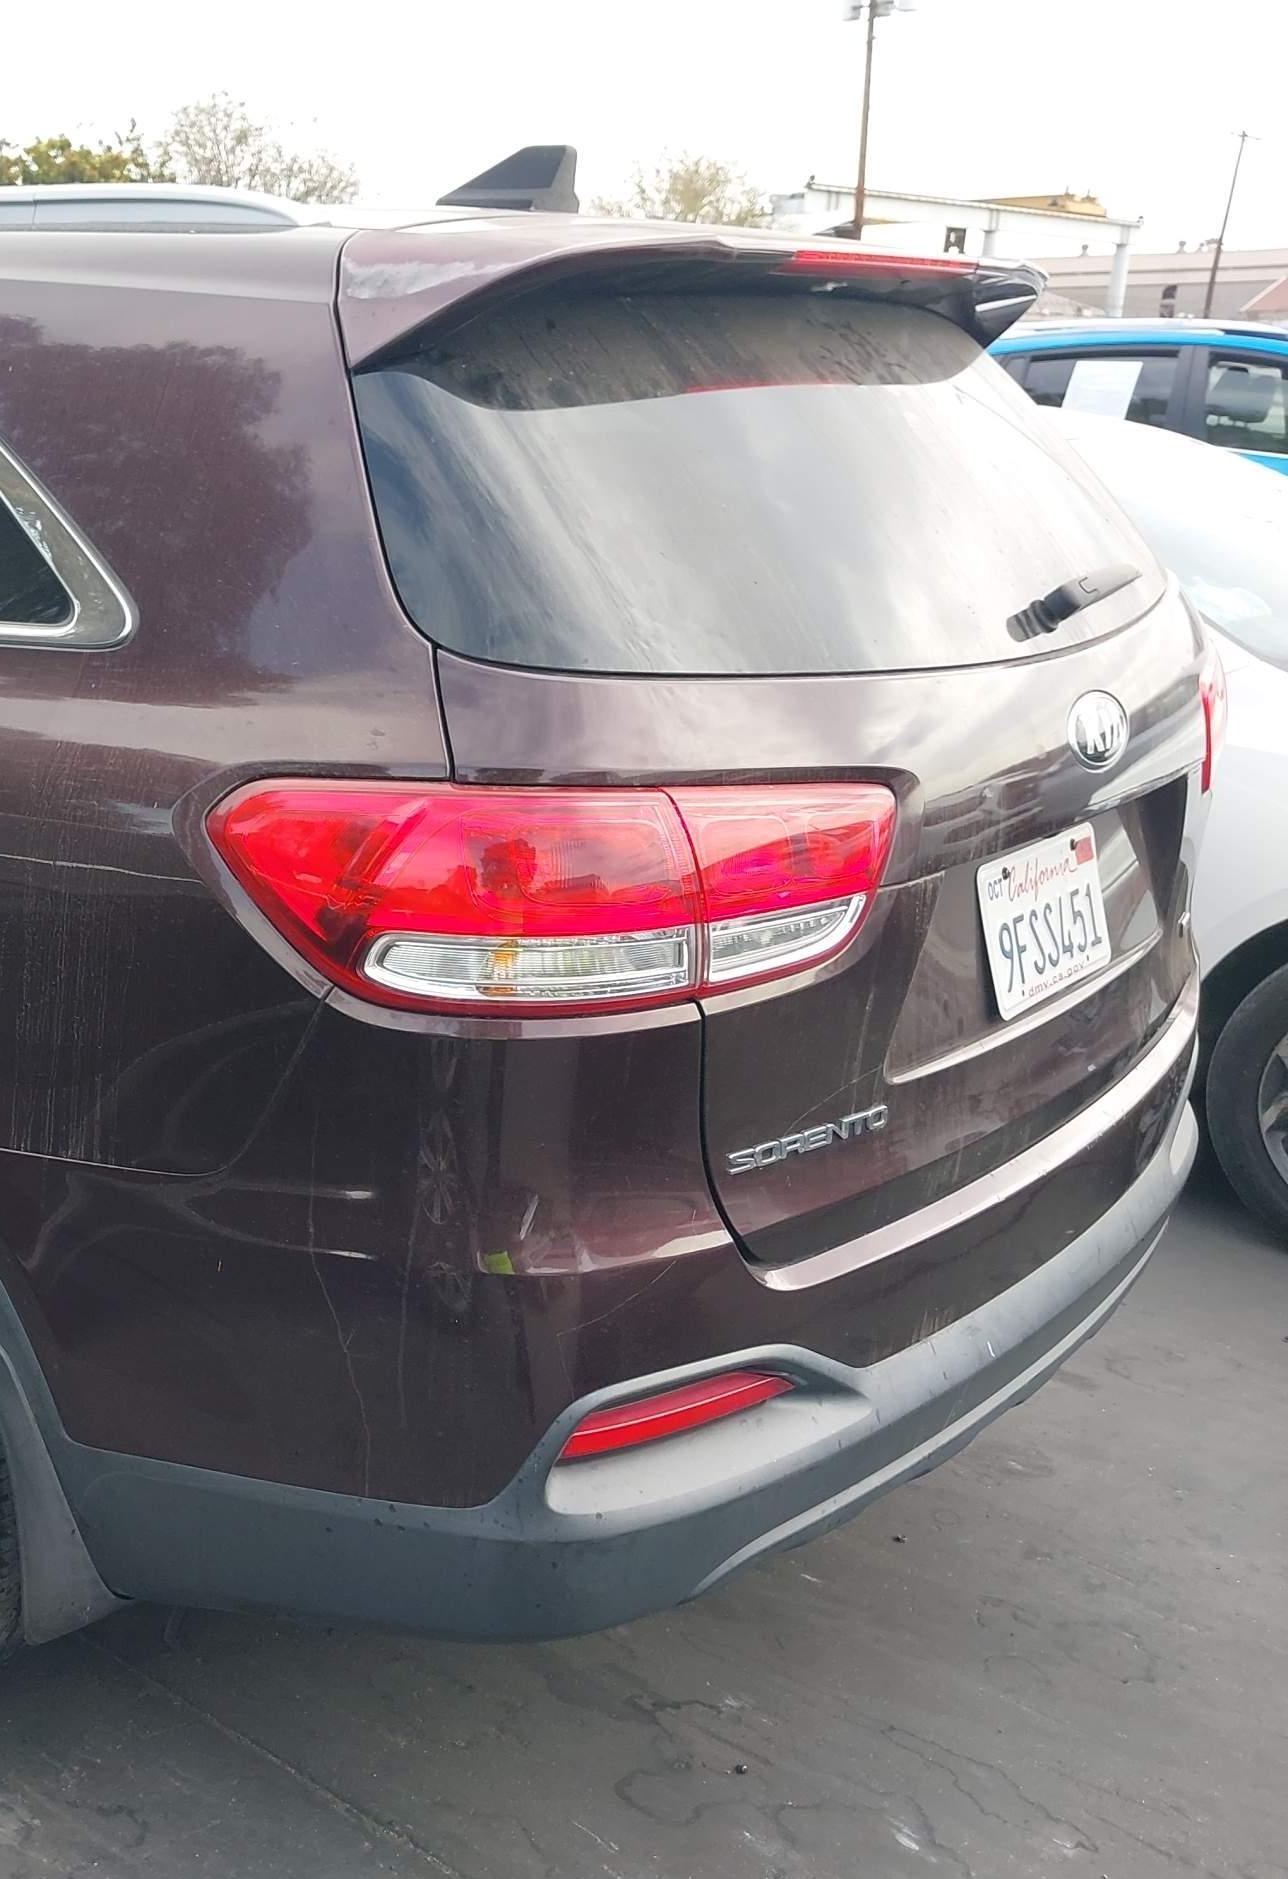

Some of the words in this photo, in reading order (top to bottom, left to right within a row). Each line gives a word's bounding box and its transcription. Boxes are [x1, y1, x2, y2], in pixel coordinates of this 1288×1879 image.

[988, 877, 1004, 901] OCT
[1007, 857, 1078, 902] California
[998, 883, 1103, 993] 9FSS451
[727, 1105, 888, 1175] SORENTO
